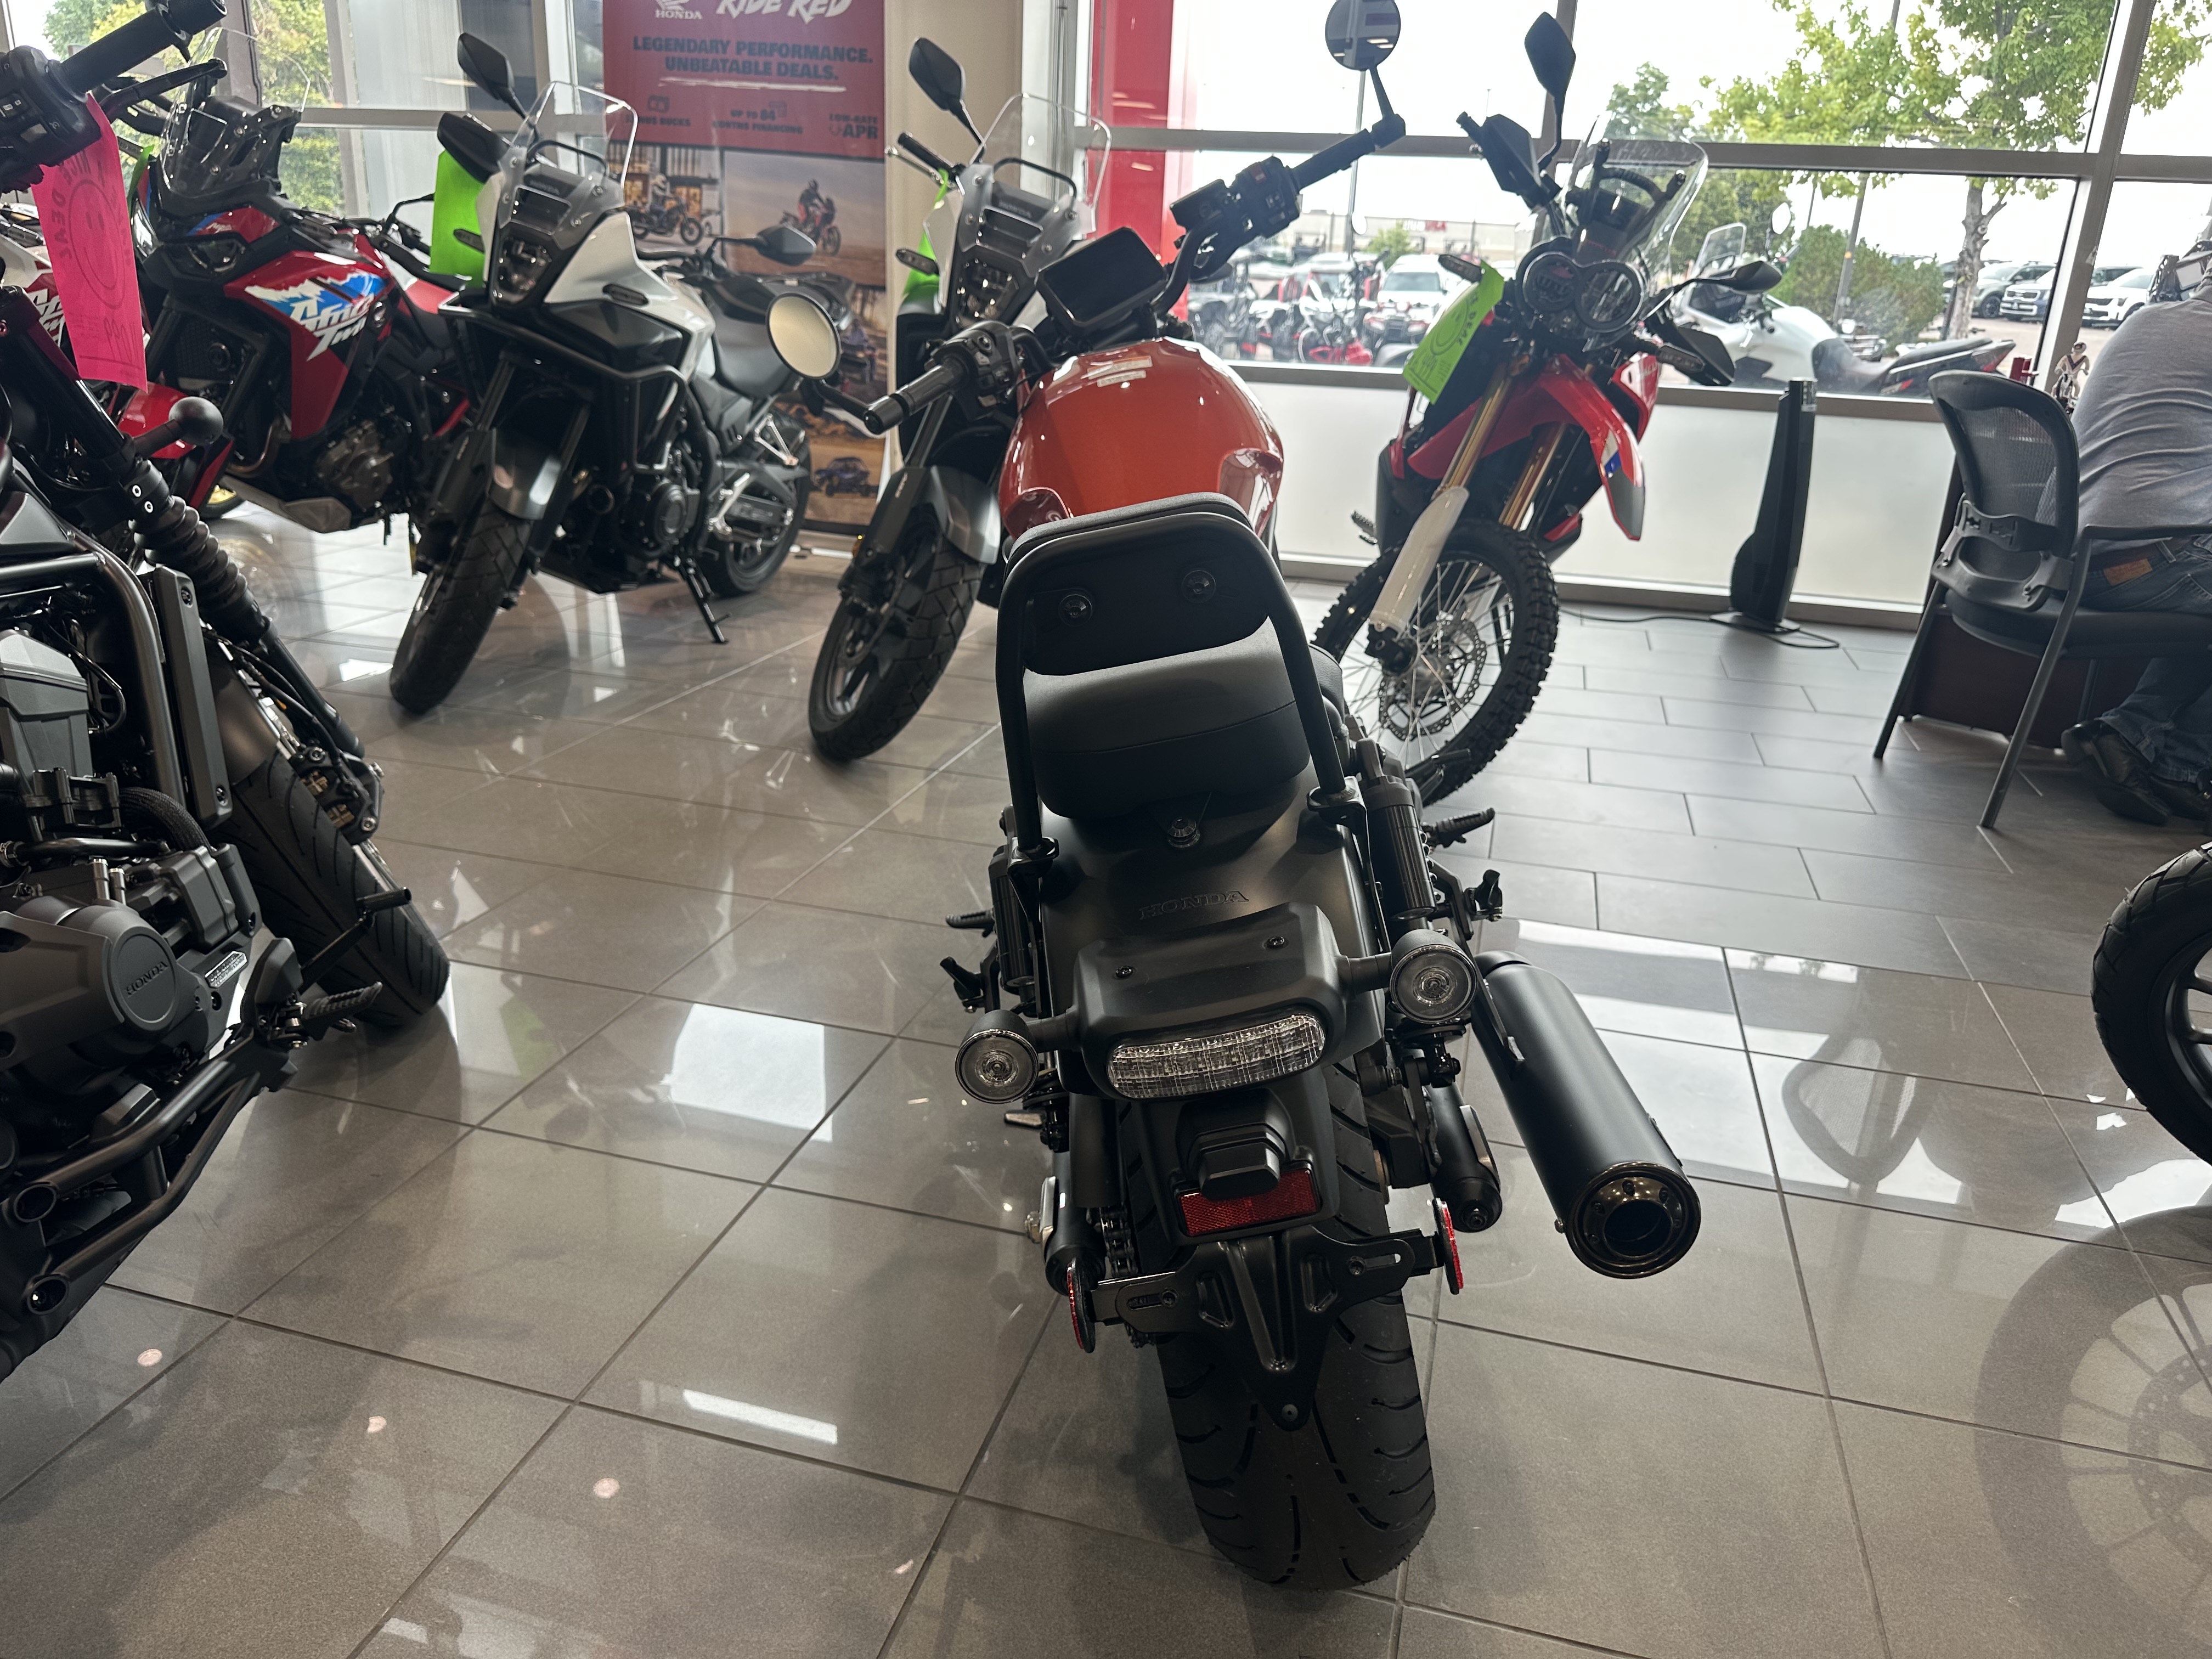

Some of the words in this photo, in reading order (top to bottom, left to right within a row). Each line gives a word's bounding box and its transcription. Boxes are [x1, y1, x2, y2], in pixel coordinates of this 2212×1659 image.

[655, 10, 703, 20] HONDA
[633, 36, 731, 55] LEGENDARY
[736, 40, 873, 63] PERFORMANCE.
[665, 56, 772, 76] UNBEATABLE
[776, 61, 839, 81] DEALS.
[842, 124, 879, 139] APR
[1139, 890, 1249, 920] HONDA
[126, 961, 168, 996] HONDA
